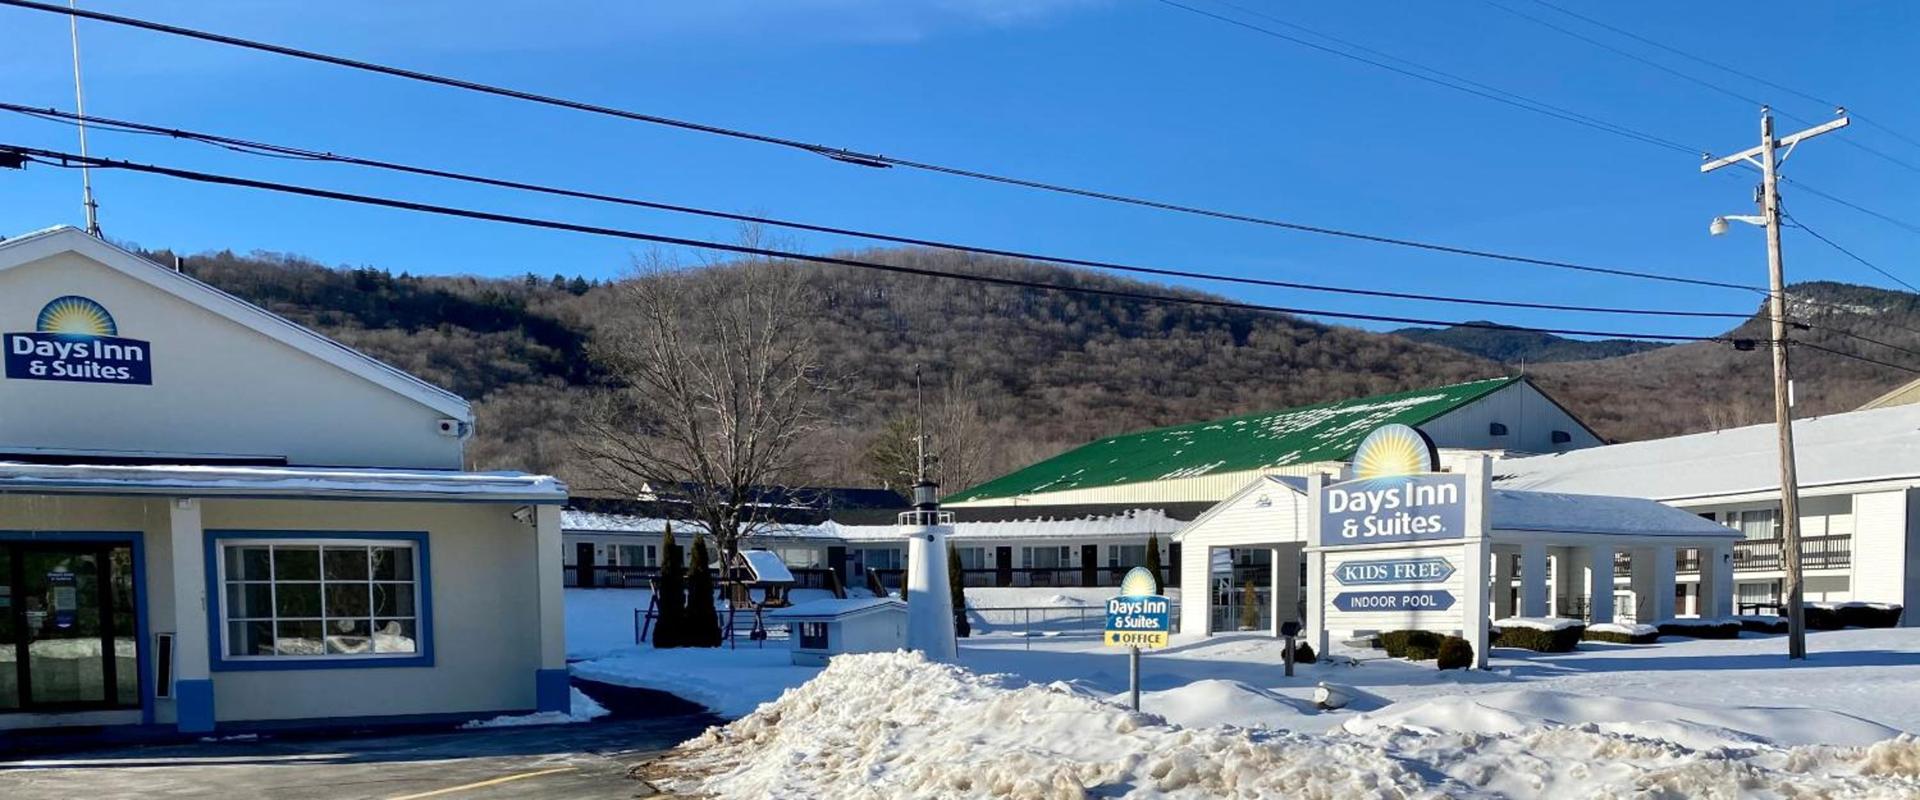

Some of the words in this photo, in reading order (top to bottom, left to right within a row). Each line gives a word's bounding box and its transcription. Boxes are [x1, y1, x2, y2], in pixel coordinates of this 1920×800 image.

[12, 335, 89, 359] Days
[93, 340, 143, 361] Inn
[29, 360, 47, 376] &
[1328, 488, 1400, 514] Days
[1406, 482, 1457, 507] Inn
[1342, 519, 1358, 538] &
[1345, 565, 1388, 580] KIDS
[1394, 562, 1441, 578] FREE
[1109, 599, 1142, 615] Days
[1143, 599, 1166, 614] Inn
[1351, 595, 1396, 608] INDOOR
[1402, 594, 1437, 607] POOL
[1115, 616, 1123, 628] &
[1122, 633, 1162, 643] OFFICE
